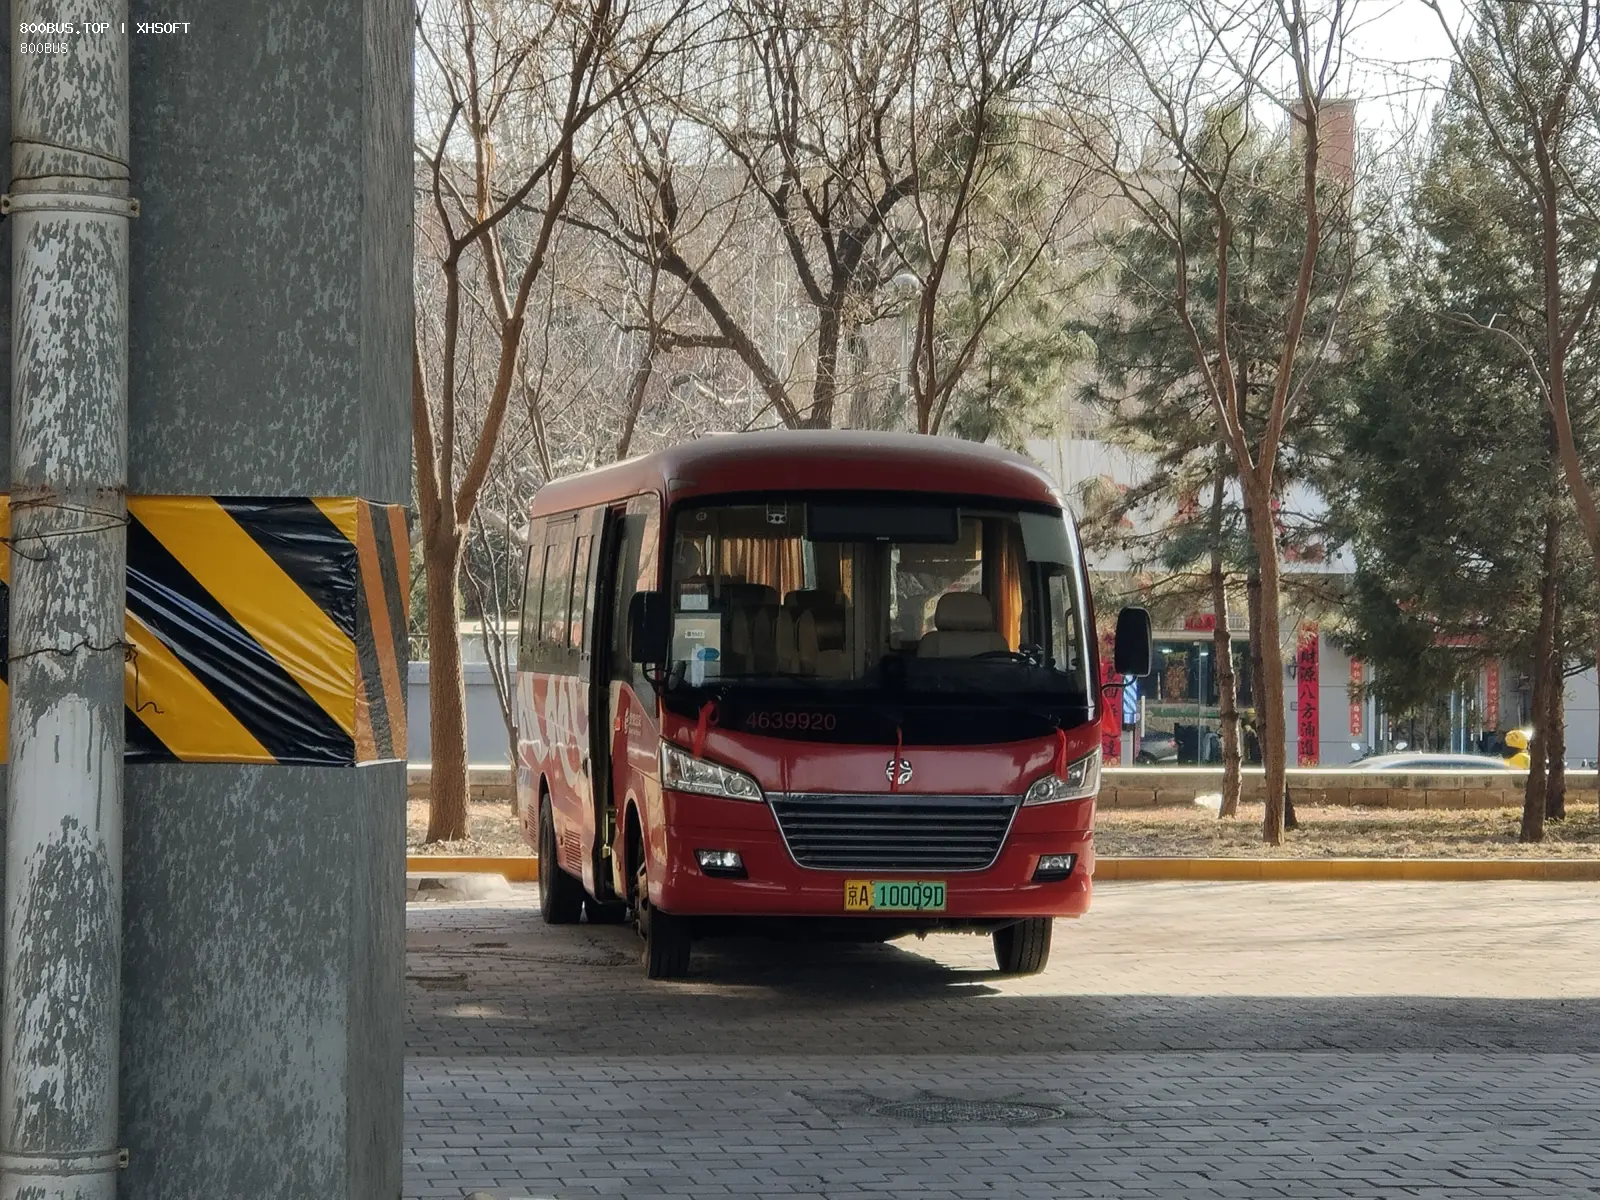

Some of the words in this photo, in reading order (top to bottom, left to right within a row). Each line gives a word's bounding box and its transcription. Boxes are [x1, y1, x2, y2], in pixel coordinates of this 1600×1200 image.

[746, 711, 836, 730] 4639920
[847, 885, 869, 906] 京A
[880, 885, 944, 907] 10009D
